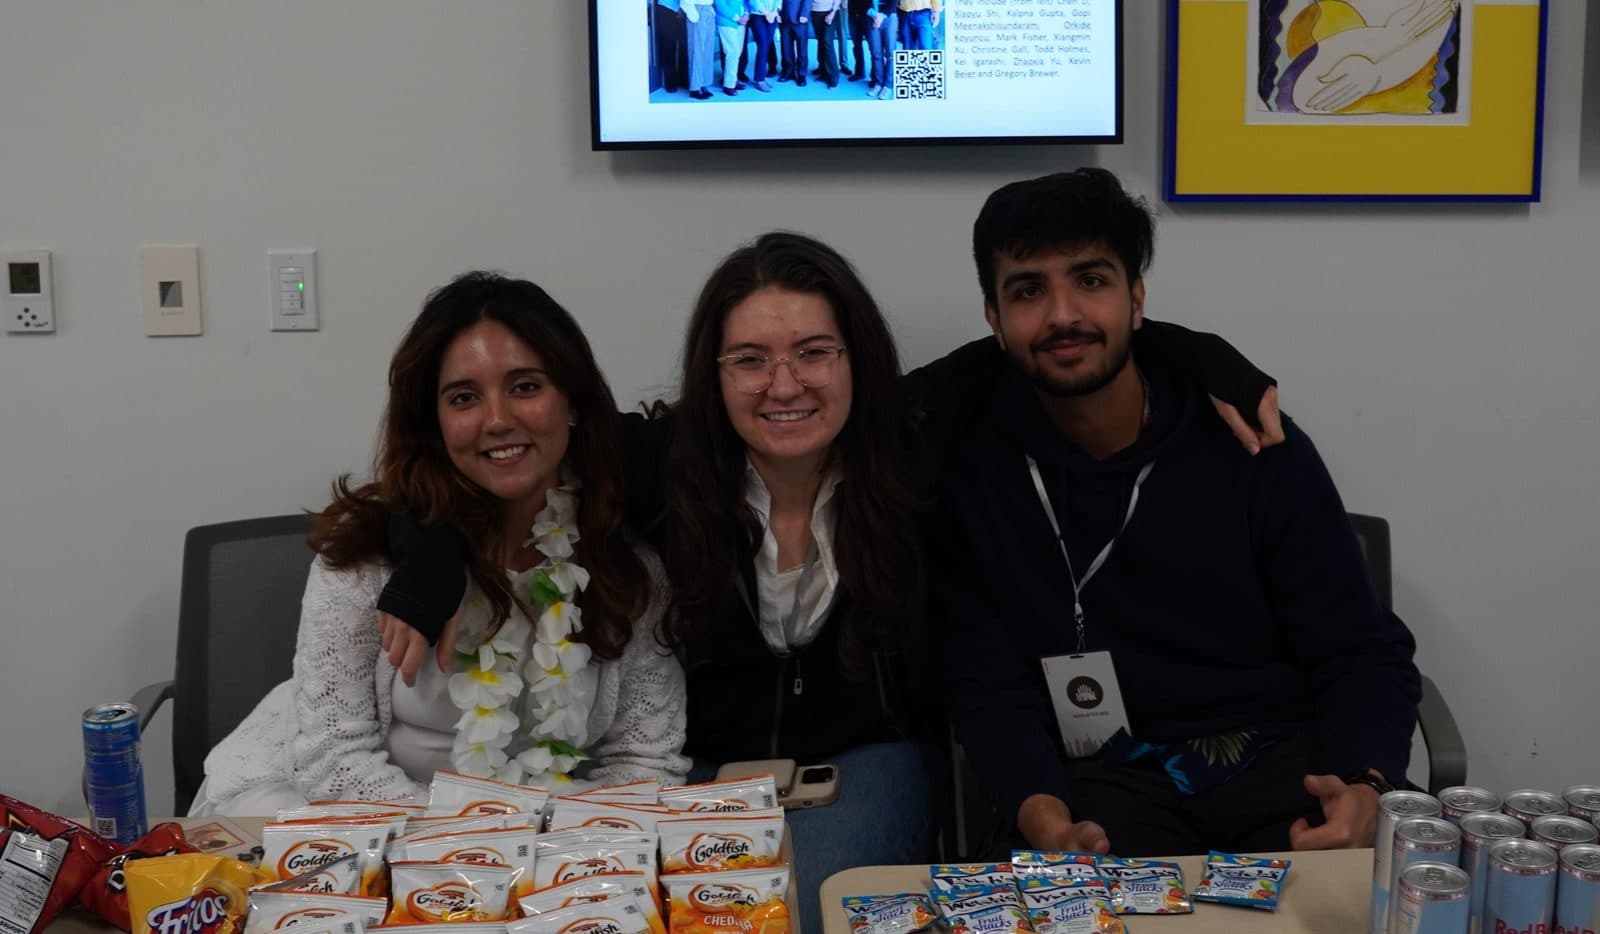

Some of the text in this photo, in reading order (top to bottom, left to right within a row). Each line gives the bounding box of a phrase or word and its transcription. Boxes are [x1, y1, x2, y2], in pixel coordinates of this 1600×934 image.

[996, 33, 1017, 42] Mark
[1069, 57, 1092, 65] Kevin
[977, 70, 993, 78] and
[994, 69, 1027, 80] Gregory
[695, 842, 749, 863] Goldfish
[1061, 902, 1086, 914] Fruit
[1055, 907, 1095, 922] Snacks
[973, 919, 1012, 932] Snacks
